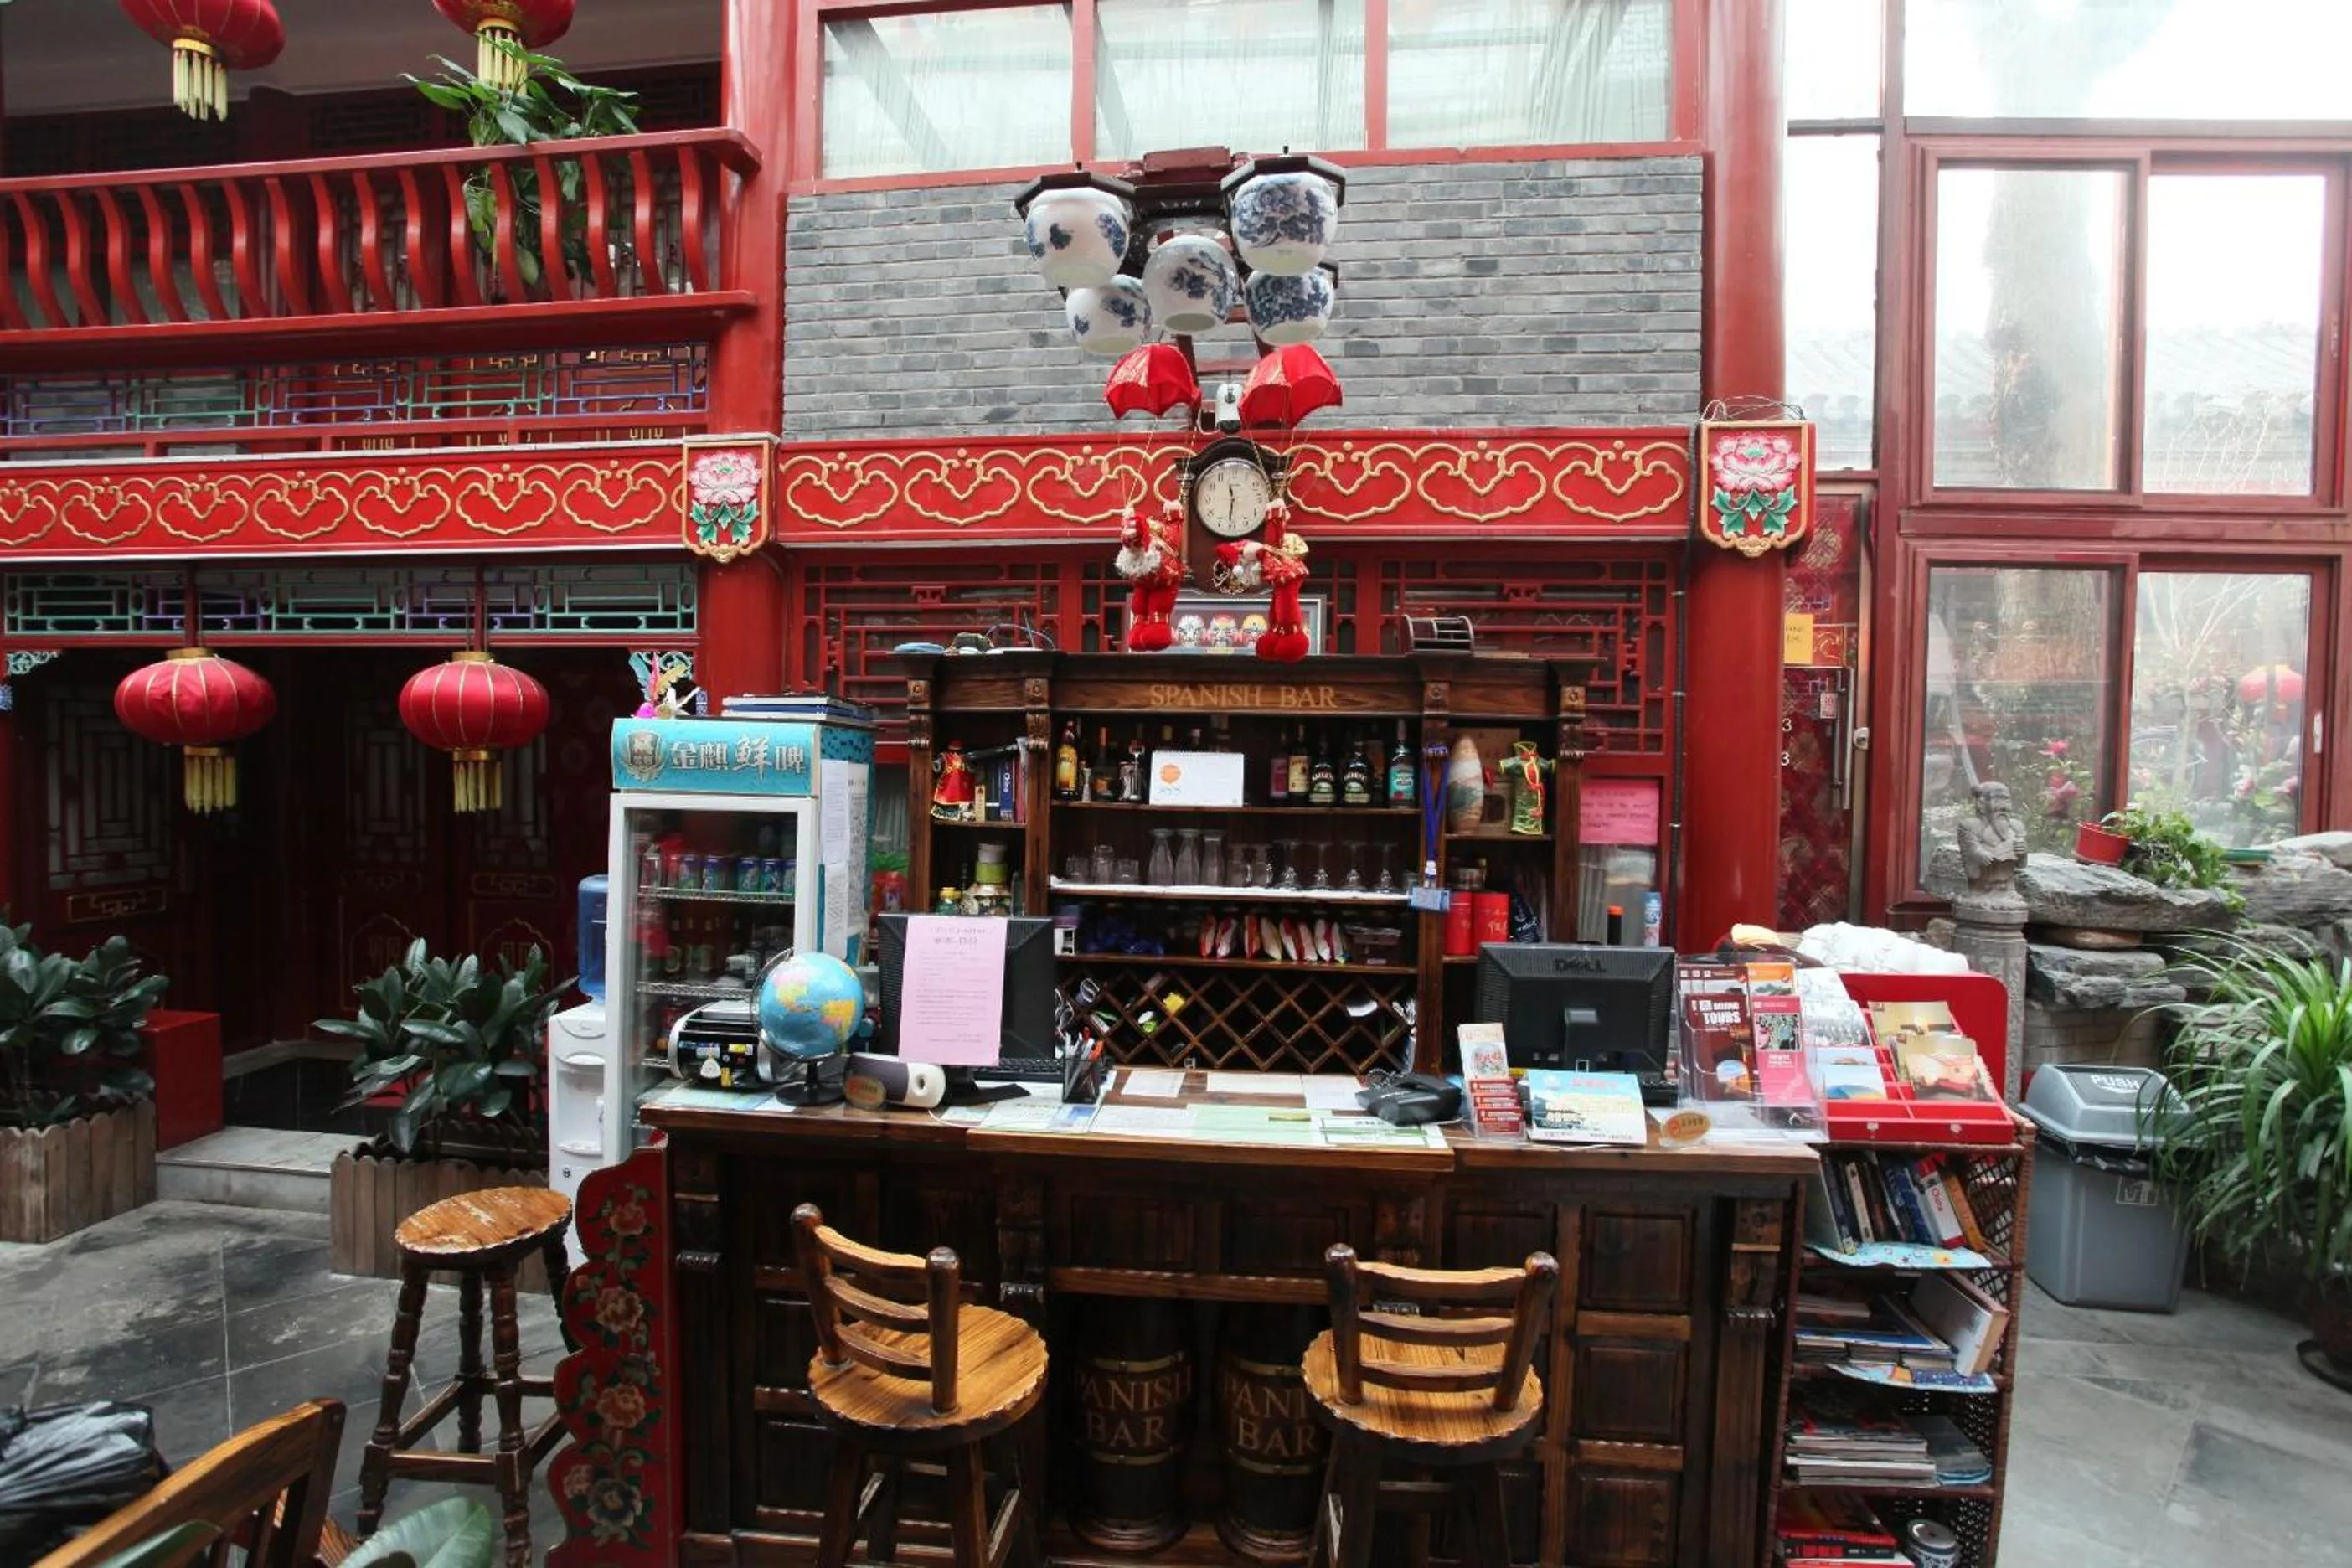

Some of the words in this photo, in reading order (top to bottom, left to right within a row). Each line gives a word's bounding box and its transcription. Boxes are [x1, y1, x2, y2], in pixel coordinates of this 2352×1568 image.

[1150, 683, 1262, 707] SPANISH
[1279, 685, 1338, 709] BAR
[1555, 957, 1607, 972] DELL
[2090, 1074, 2141, 1091] PUSH
[1086, 1411, 1167, 1447] BAR
[1237, 1416, 1318, 1458] BAR
